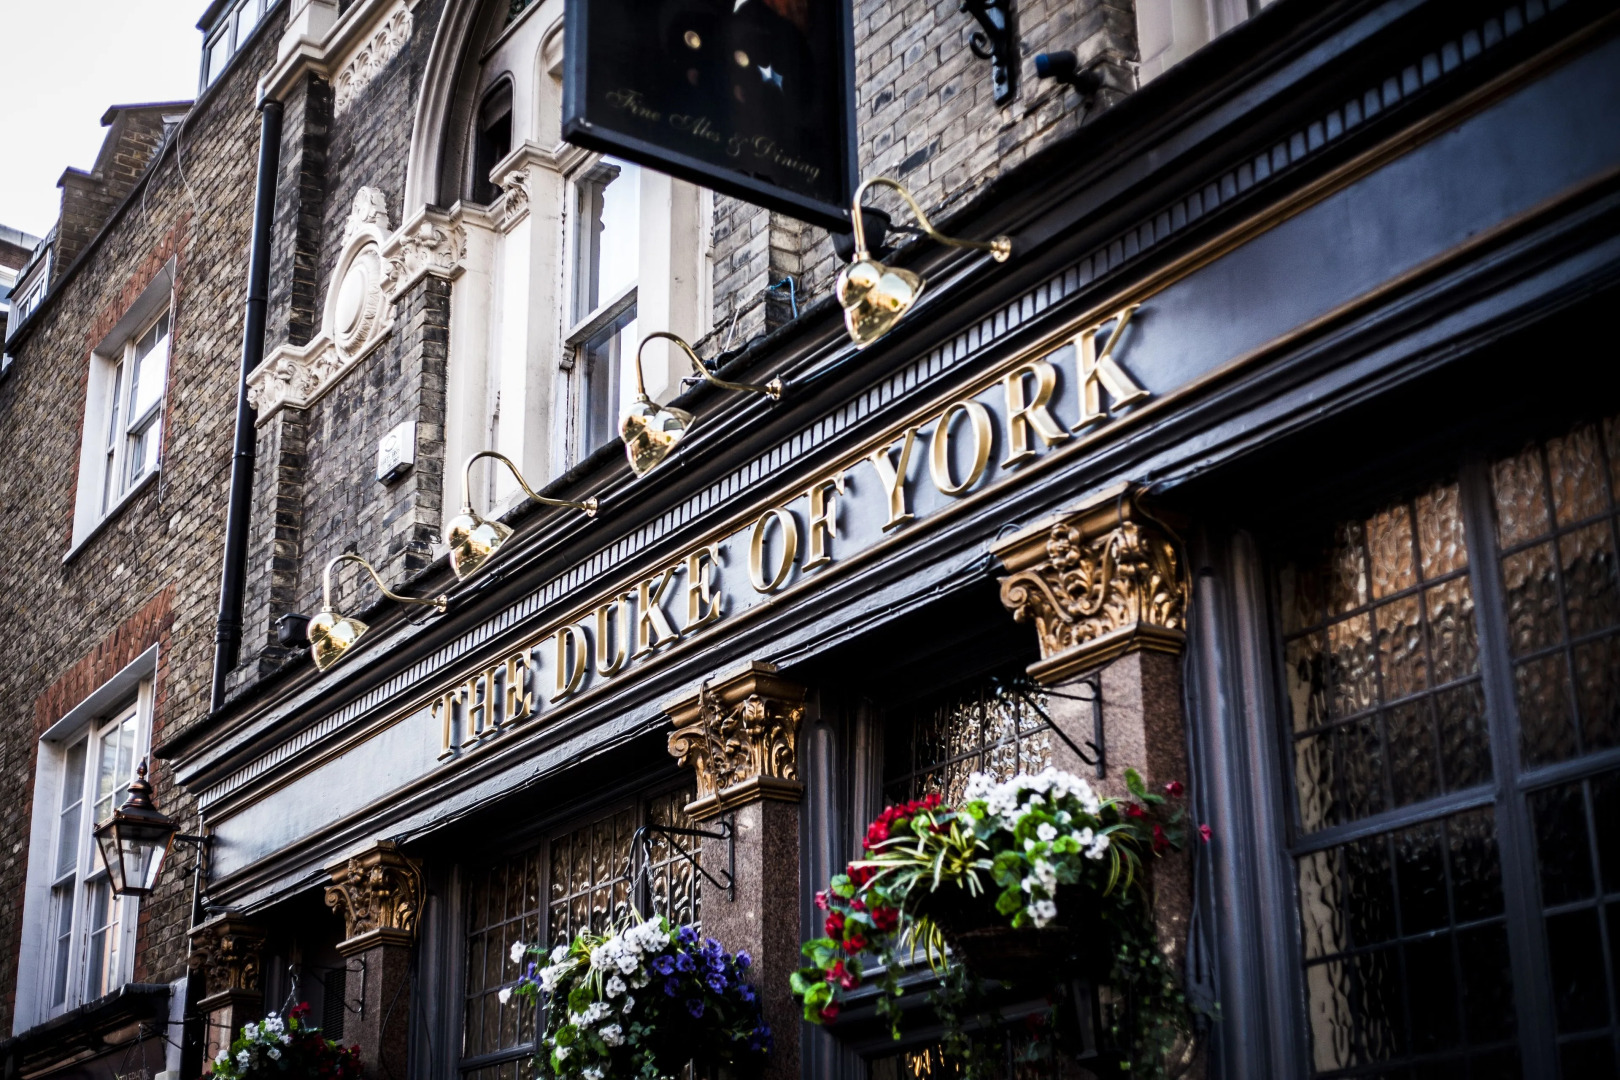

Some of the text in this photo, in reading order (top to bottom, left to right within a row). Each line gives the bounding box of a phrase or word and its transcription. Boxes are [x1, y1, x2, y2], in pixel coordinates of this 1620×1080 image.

[605, 88, 820, 181] Fine Ales & Dining
[431, 303, 1150, 761] THE DUKE OF YORK
